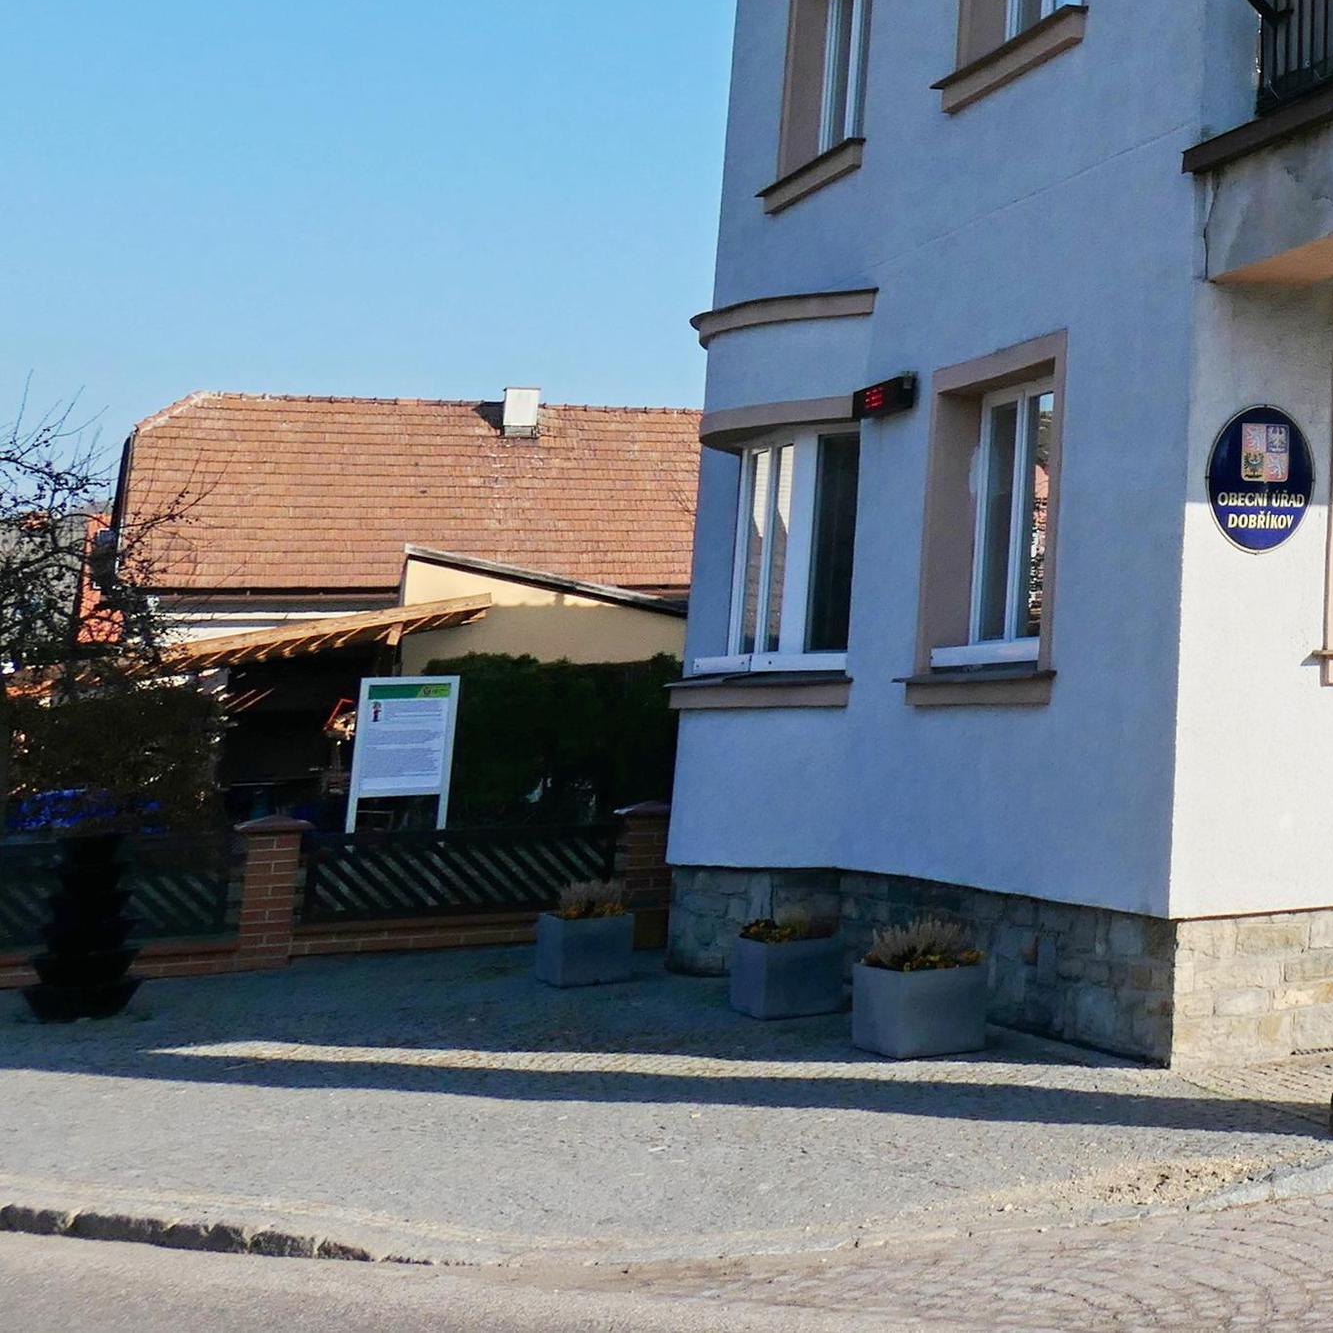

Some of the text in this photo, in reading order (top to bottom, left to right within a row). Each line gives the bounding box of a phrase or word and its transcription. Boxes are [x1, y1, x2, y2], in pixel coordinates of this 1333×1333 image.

[1217, 489, 1305, 508] OBECNÍ ÚŘAD
[1227, 510, 1295, 530] DOBŘÍKOV
